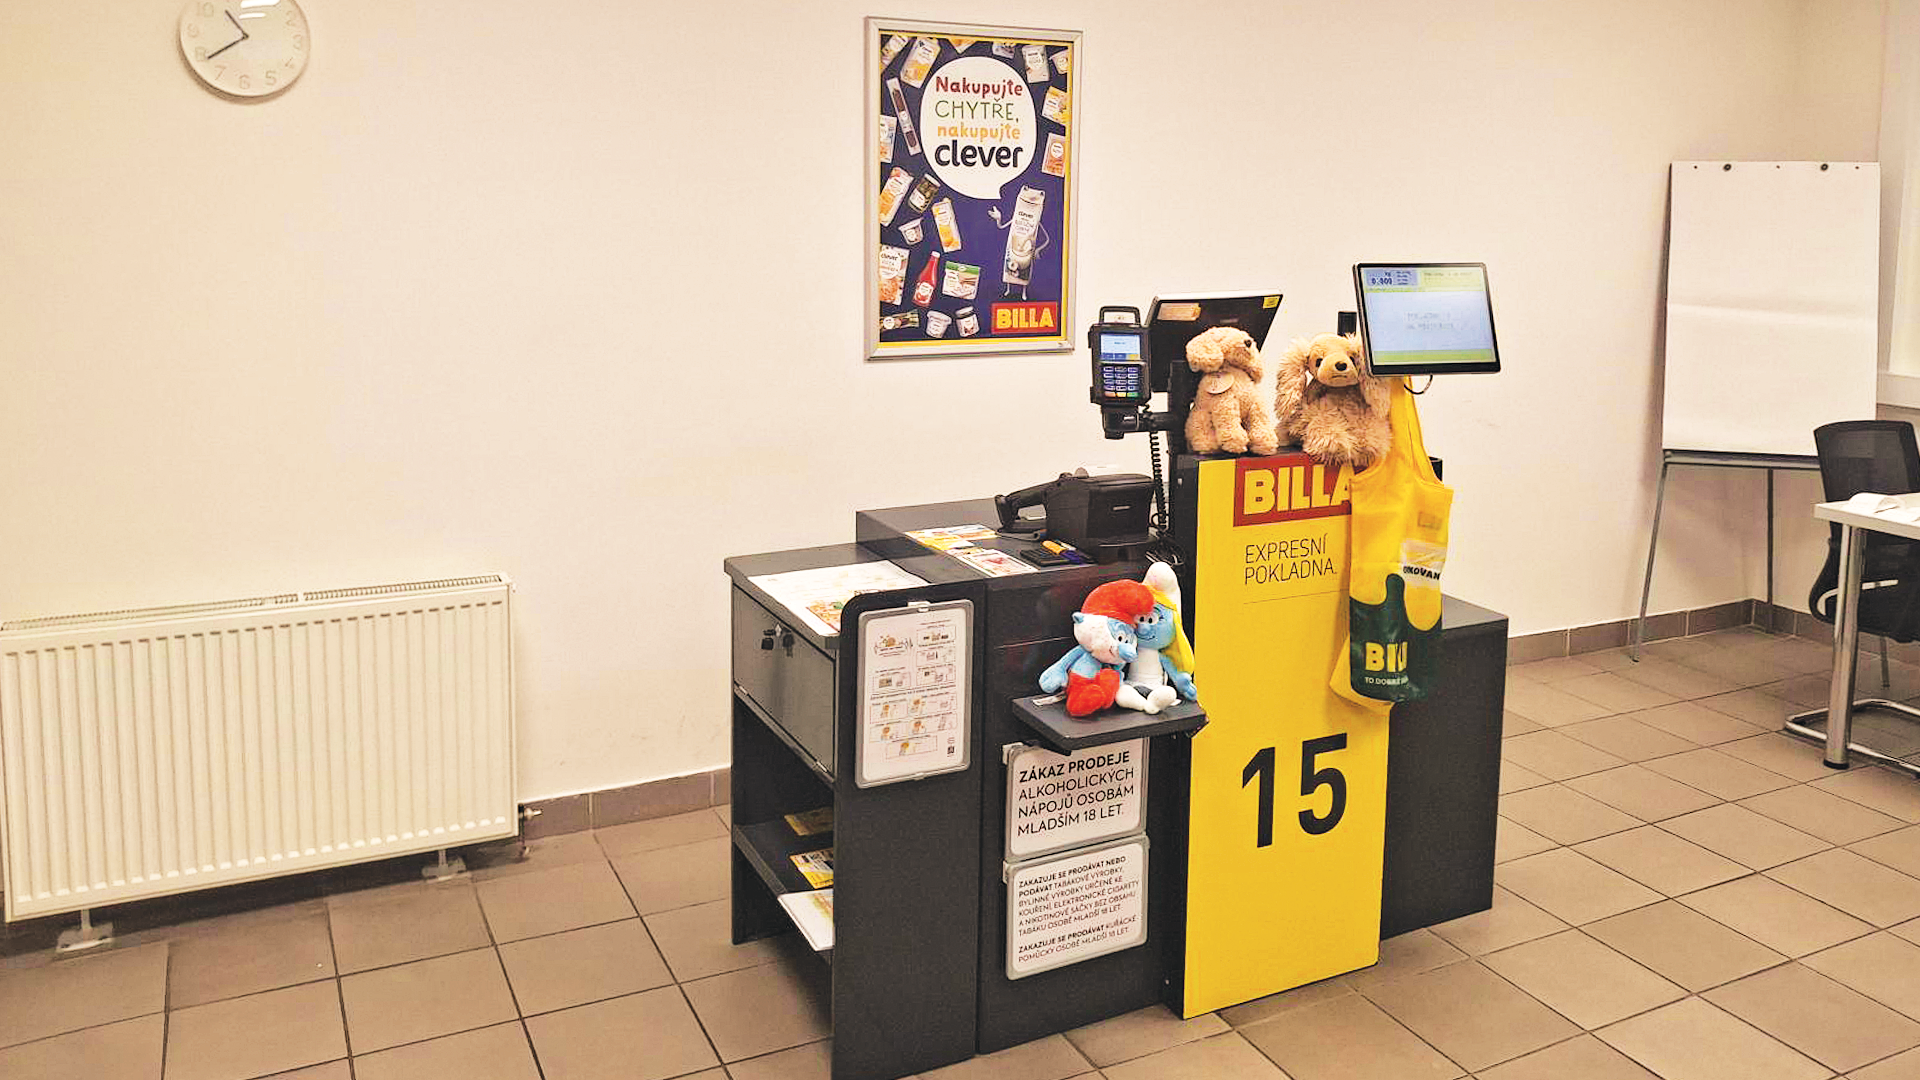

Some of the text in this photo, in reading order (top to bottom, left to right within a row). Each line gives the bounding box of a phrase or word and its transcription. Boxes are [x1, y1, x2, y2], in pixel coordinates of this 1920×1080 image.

[936, 76, 1023, 98] Nakupujte
[935, 98, 1019, 122] CHYTŘE,
[938, 122, 1020, 142] nakupujte
[934, 139, 1024, 168] clever
[996, 308, 1054, 328] BILLA
[1244, 464, 1350, 514] BILLA
[1246, 532, 1328, 564] EXPRESNÍ
[1019, 751, 1130, 782] ZÁKAZ PRODEJE
[1018, 768, 1134, 801] ALKOHOLICKÝCH
[1242, 732, 1348, 848] 15
[1018, 784, 1134, 818] NÁPOJŮ OSOBÁM
[1018, 812, 1080, 836] MLADŠÍM
[1084, 808, 1096, 822] 18
[1018, 855, 1126, 887] ZAKAZUJE SE PRODÁVAT NEBO
[1018, 882, 1052, 897] PODÁVAT
[1018, 937, 1055, 953] ZAKAZUJE
[1067, 924, 1103, 939] PRODÁVAT
